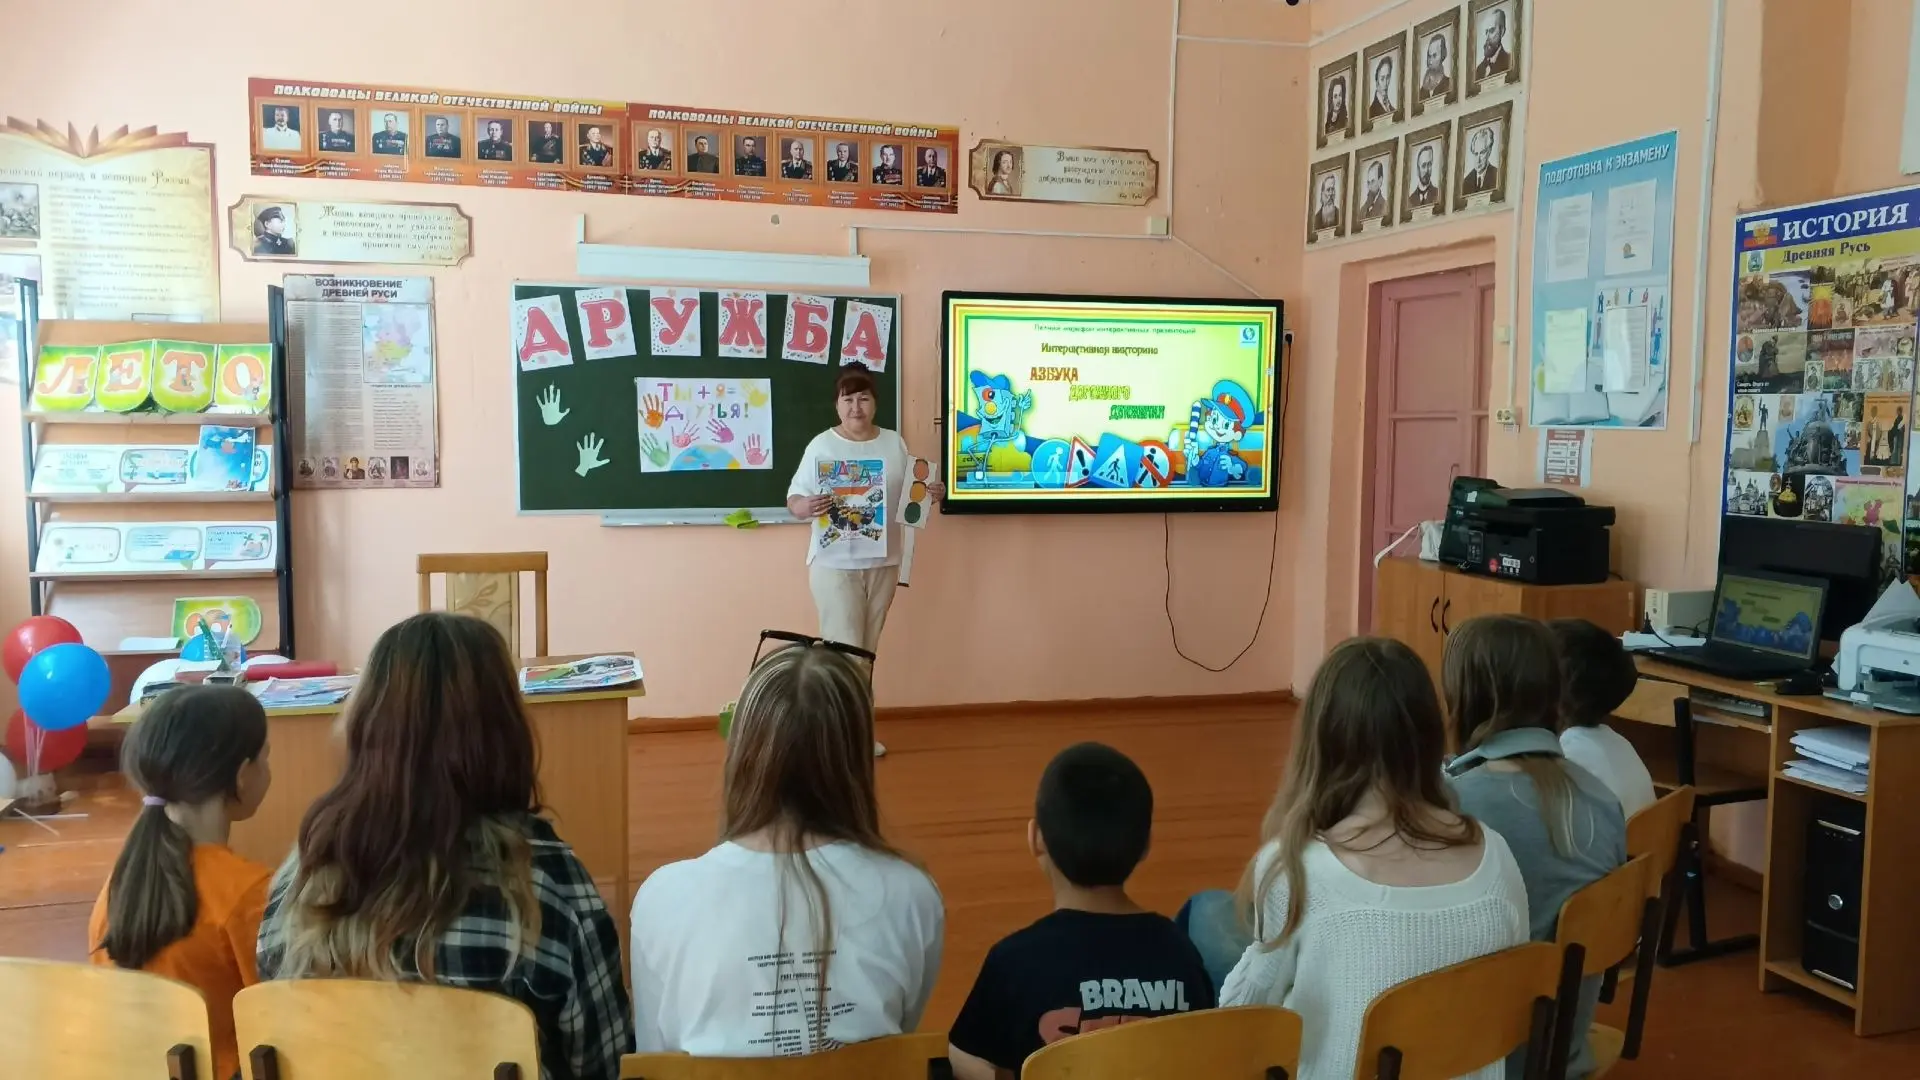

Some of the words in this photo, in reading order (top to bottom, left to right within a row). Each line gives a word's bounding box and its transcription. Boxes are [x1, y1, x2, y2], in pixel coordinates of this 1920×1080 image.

[273, 85, 370, 101] ПОЛКОВОДЦЫ
[375, 91, 438, 106] ВЕЛИКОЙ
[442, 95, 549, 112] ОТЕЧЕСТВЕННОЙ
[552, 101, 602, 115] ВОЙНЫ
[648, 109, 734, 125] ПОЛКОВОДЦЫ
[738, 115, 793, 129] ВЕЛИКОЙ
[797, 120, 892, 135] ОТЕЧЕСТВЕННОЙ
[894, 125, 938, 138] ВОЙНЫ
[1545, 160, 1602, 185] ПОДГОТОВКА
[1606, 157, 1614, 171] К
[1616, 143, 1670, 169] ЭКЗАМЕНУ
[1782, 203, 1909, 242] ИСТОРИЯ
[1781, 247, 1835, 264] Древняя
[1840, 241, 1871, 257] Русь
[315, 278, 403, 289] ВОЗНИКНОВЕНИЕ
[321, 287, 368, 298] ДРЕВНЕЙ
[371, 289, 398, 298] РУСИ
[520, 297, 885, 362] ДРУЖБА
[1041, 342, 1109, 356] Интерактивная
[1112, 345, 1158, 356] викторина
[36, 350, 265, 396] ЛЕТО
[1030, 366, 1079, 384] АЗБУКА
[664, 403, 749, 422] ДУЗЬЯ!
[1079, 978, 1190, 1011] BRAWL
